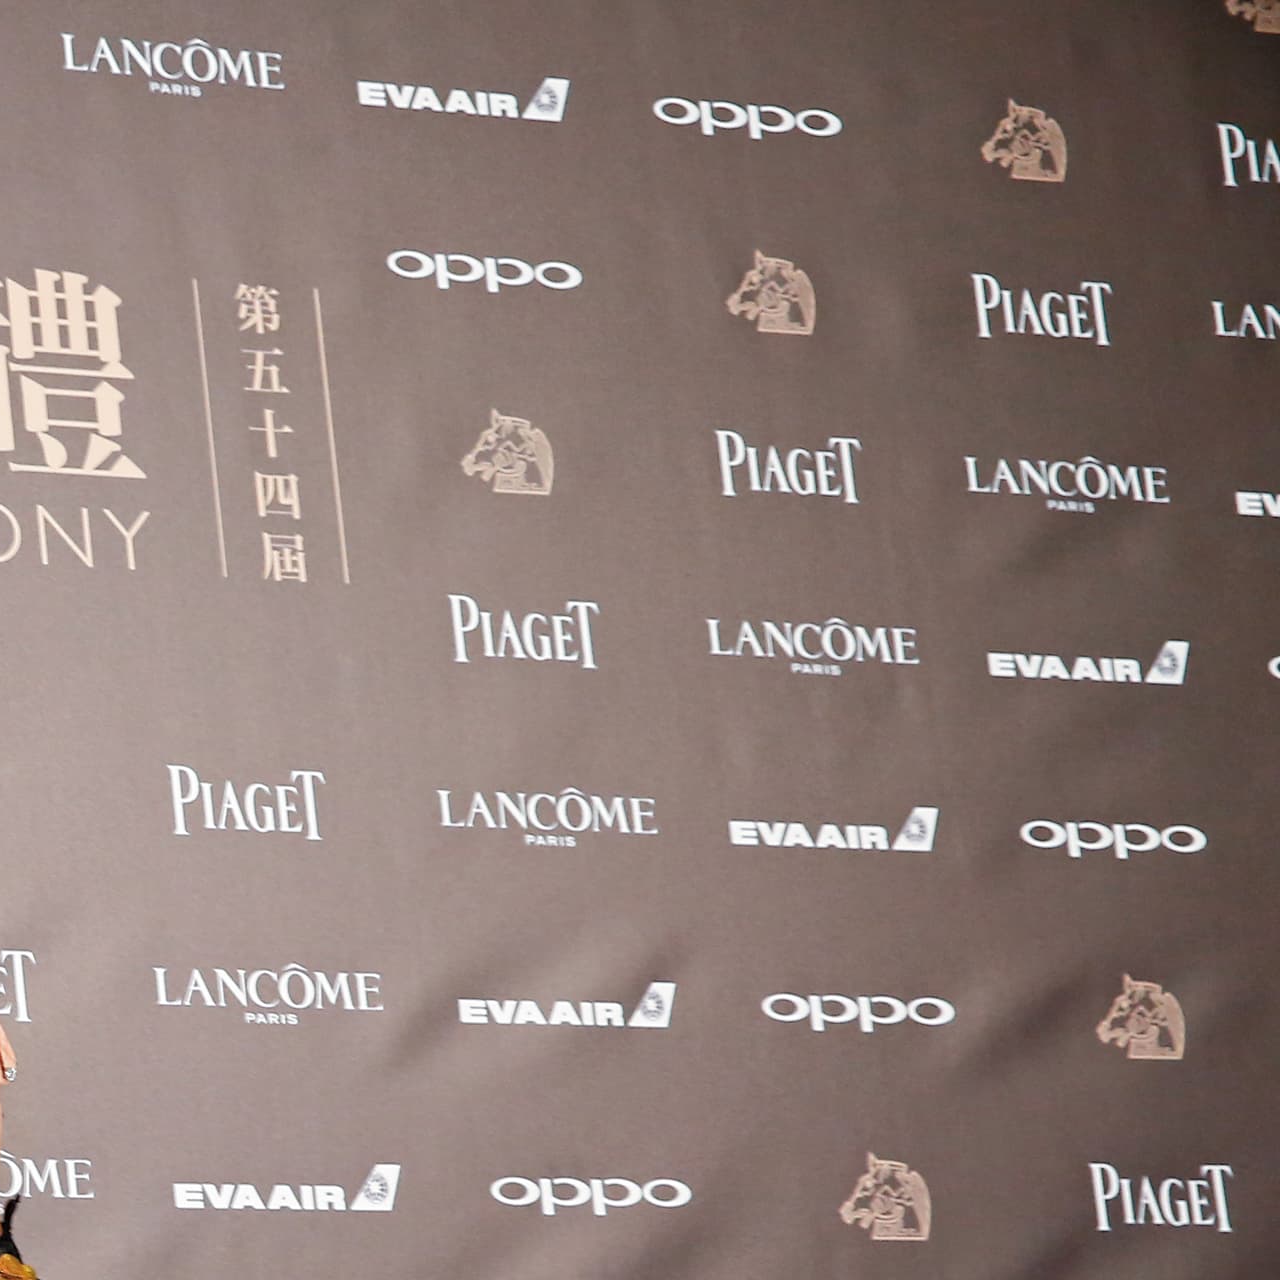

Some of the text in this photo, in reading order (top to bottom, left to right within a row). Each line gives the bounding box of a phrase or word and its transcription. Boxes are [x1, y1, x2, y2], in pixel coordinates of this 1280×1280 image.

[62, 34, 284, 89] LANCÔME
[150, 82, 201, 96] PARIS
[654, 98, 841, 139] oppo
[387, 251, 582, 292] oppo
[972, 274, 1111, 345] PIAGET
[234, 284, 308, 582] 第五十四屆
[716, 431, 860, 503] PIAGET
[965, 456, 1170, 502] LANCÔME
[1047, 500, 1094, 512] PARIS
[448, 595, 598, 668] PIAGET
[706, 618, 919, 664] LANCÔME
[792, 663, 841, 675] PARIS
[167, 765, 325, 840] PIAGET
[437, 788, 658, 834] LANCÔME
[525, 835, 576, 847] PARIS
[1021, 821, 1206, 858] oppo
[153, 964, 384, 1010] LANCÔME
[245, 1013, 298, 1024] PARIS
[762, 994, 954, 1032] oppo
[491, 1177, 691, 1215] oppo
[1090, 1164, 1232, 1232] PIAGET
